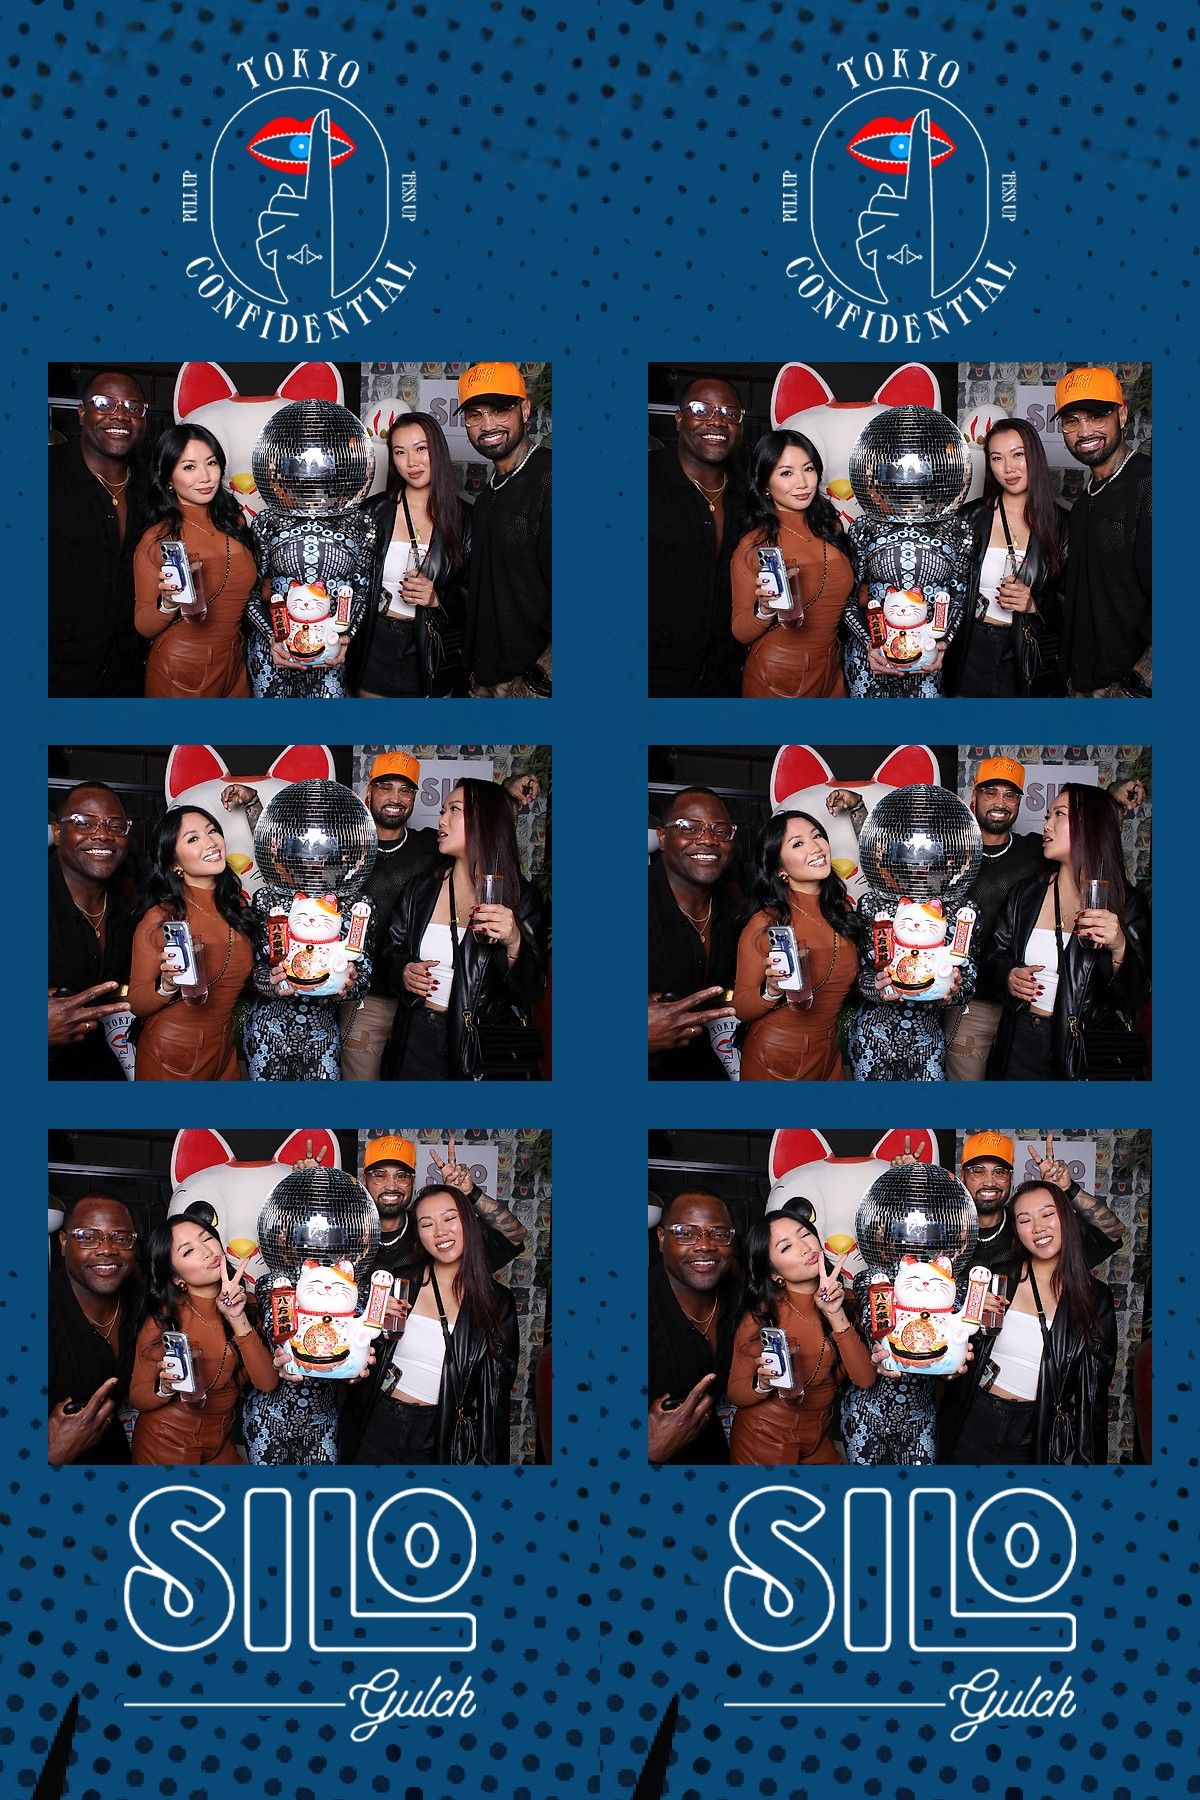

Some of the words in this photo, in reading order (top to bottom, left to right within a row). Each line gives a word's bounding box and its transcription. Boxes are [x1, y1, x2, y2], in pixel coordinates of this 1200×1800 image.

[429, 397, 466, 427] SI
[1026, 403, 1063, 433] SI
[420, 777, 460, 807] SI
[1025, 782, 1065, 812] SI
